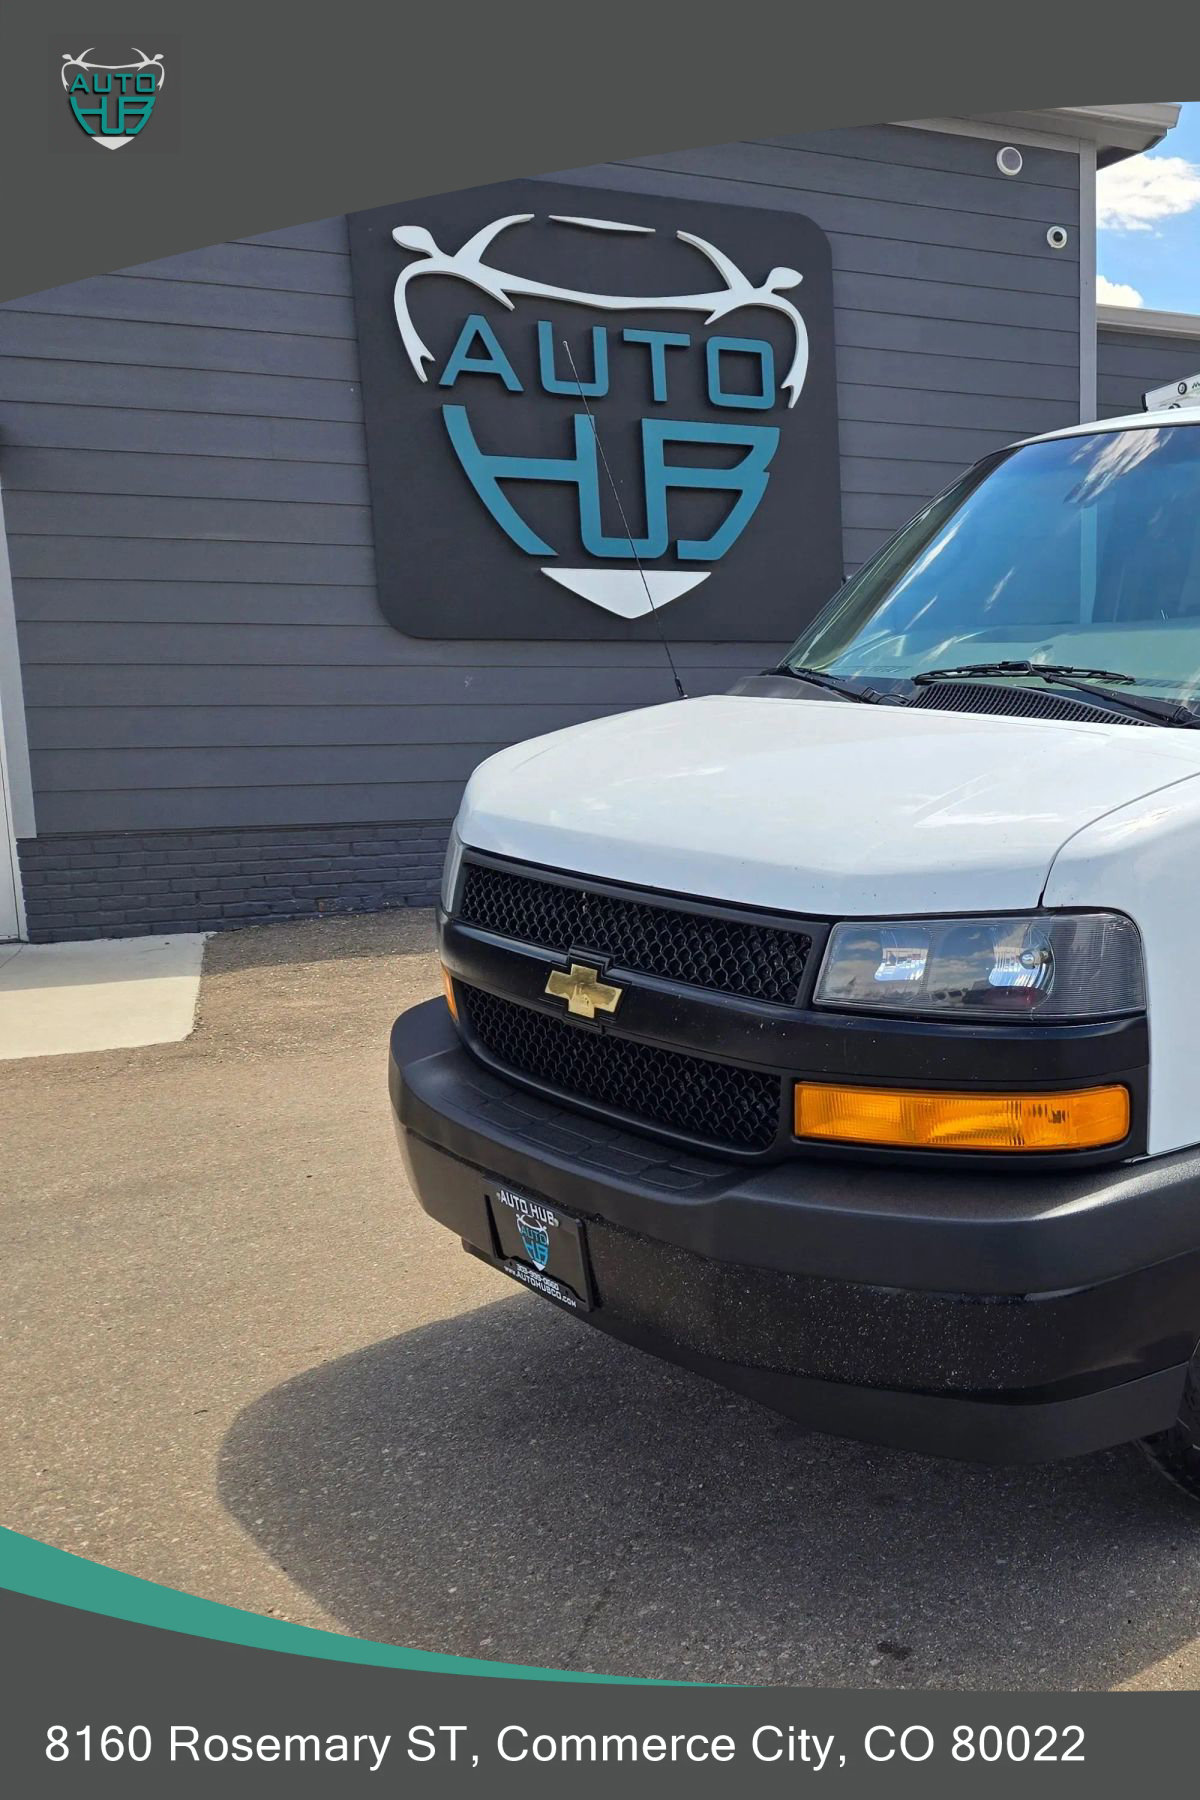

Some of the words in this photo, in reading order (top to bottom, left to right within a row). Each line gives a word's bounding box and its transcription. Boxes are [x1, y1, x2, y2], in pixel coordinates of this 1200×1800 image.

[438, 312, 776, 411] AUTO
[441, 403, 781, 562] HUB
[500, 1189, 529, 1215] AUTO
[529, 1203, 555, 1227] HUB
[519, 1225, 548, 1246] AUTO
